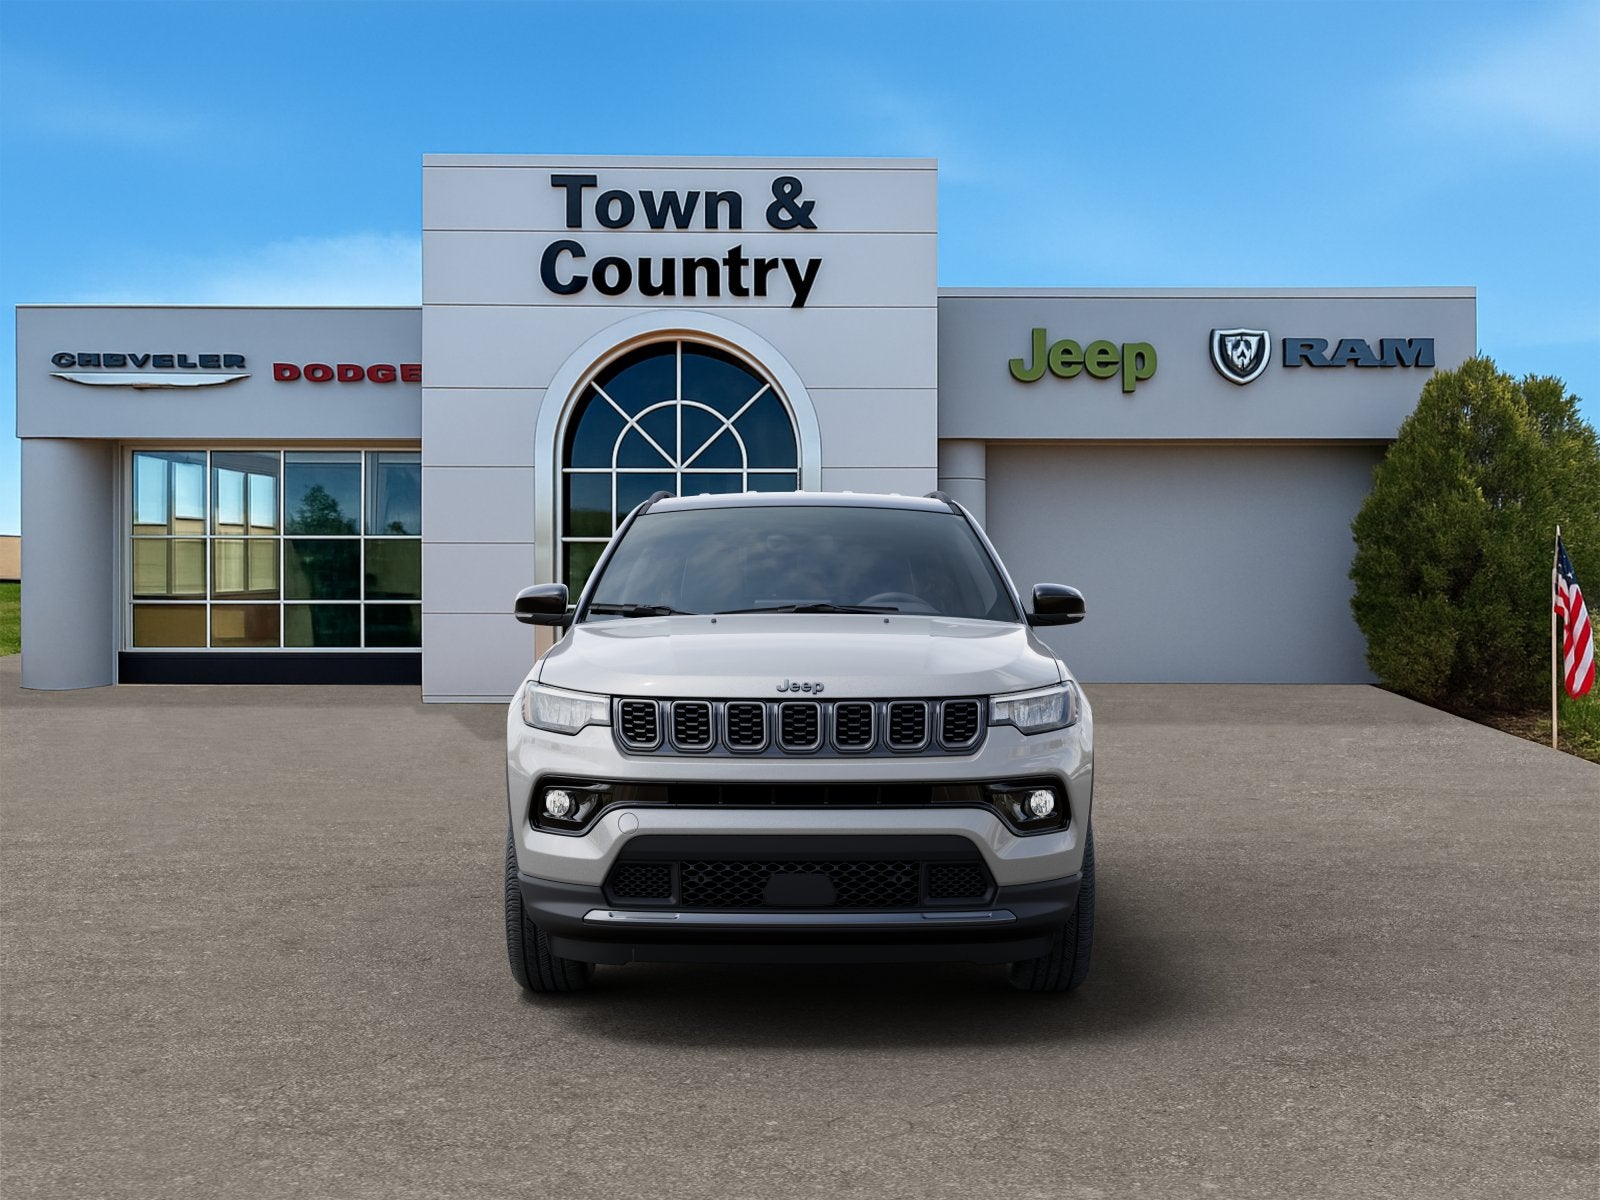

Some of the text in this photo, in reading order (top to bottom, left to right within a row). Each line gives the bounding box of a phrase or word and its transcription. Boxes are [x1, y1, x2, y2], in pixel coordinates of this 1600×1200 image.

[550, 174, 818, 230] Town &
[540, 239, 822, 308] Country
[273, 363, 422, 383] DODGE
[1009, 328, 1158, 393] Jeep
[1282, 337, 1435, 368] RAM
[776, 679, 824, 694] Jeep
